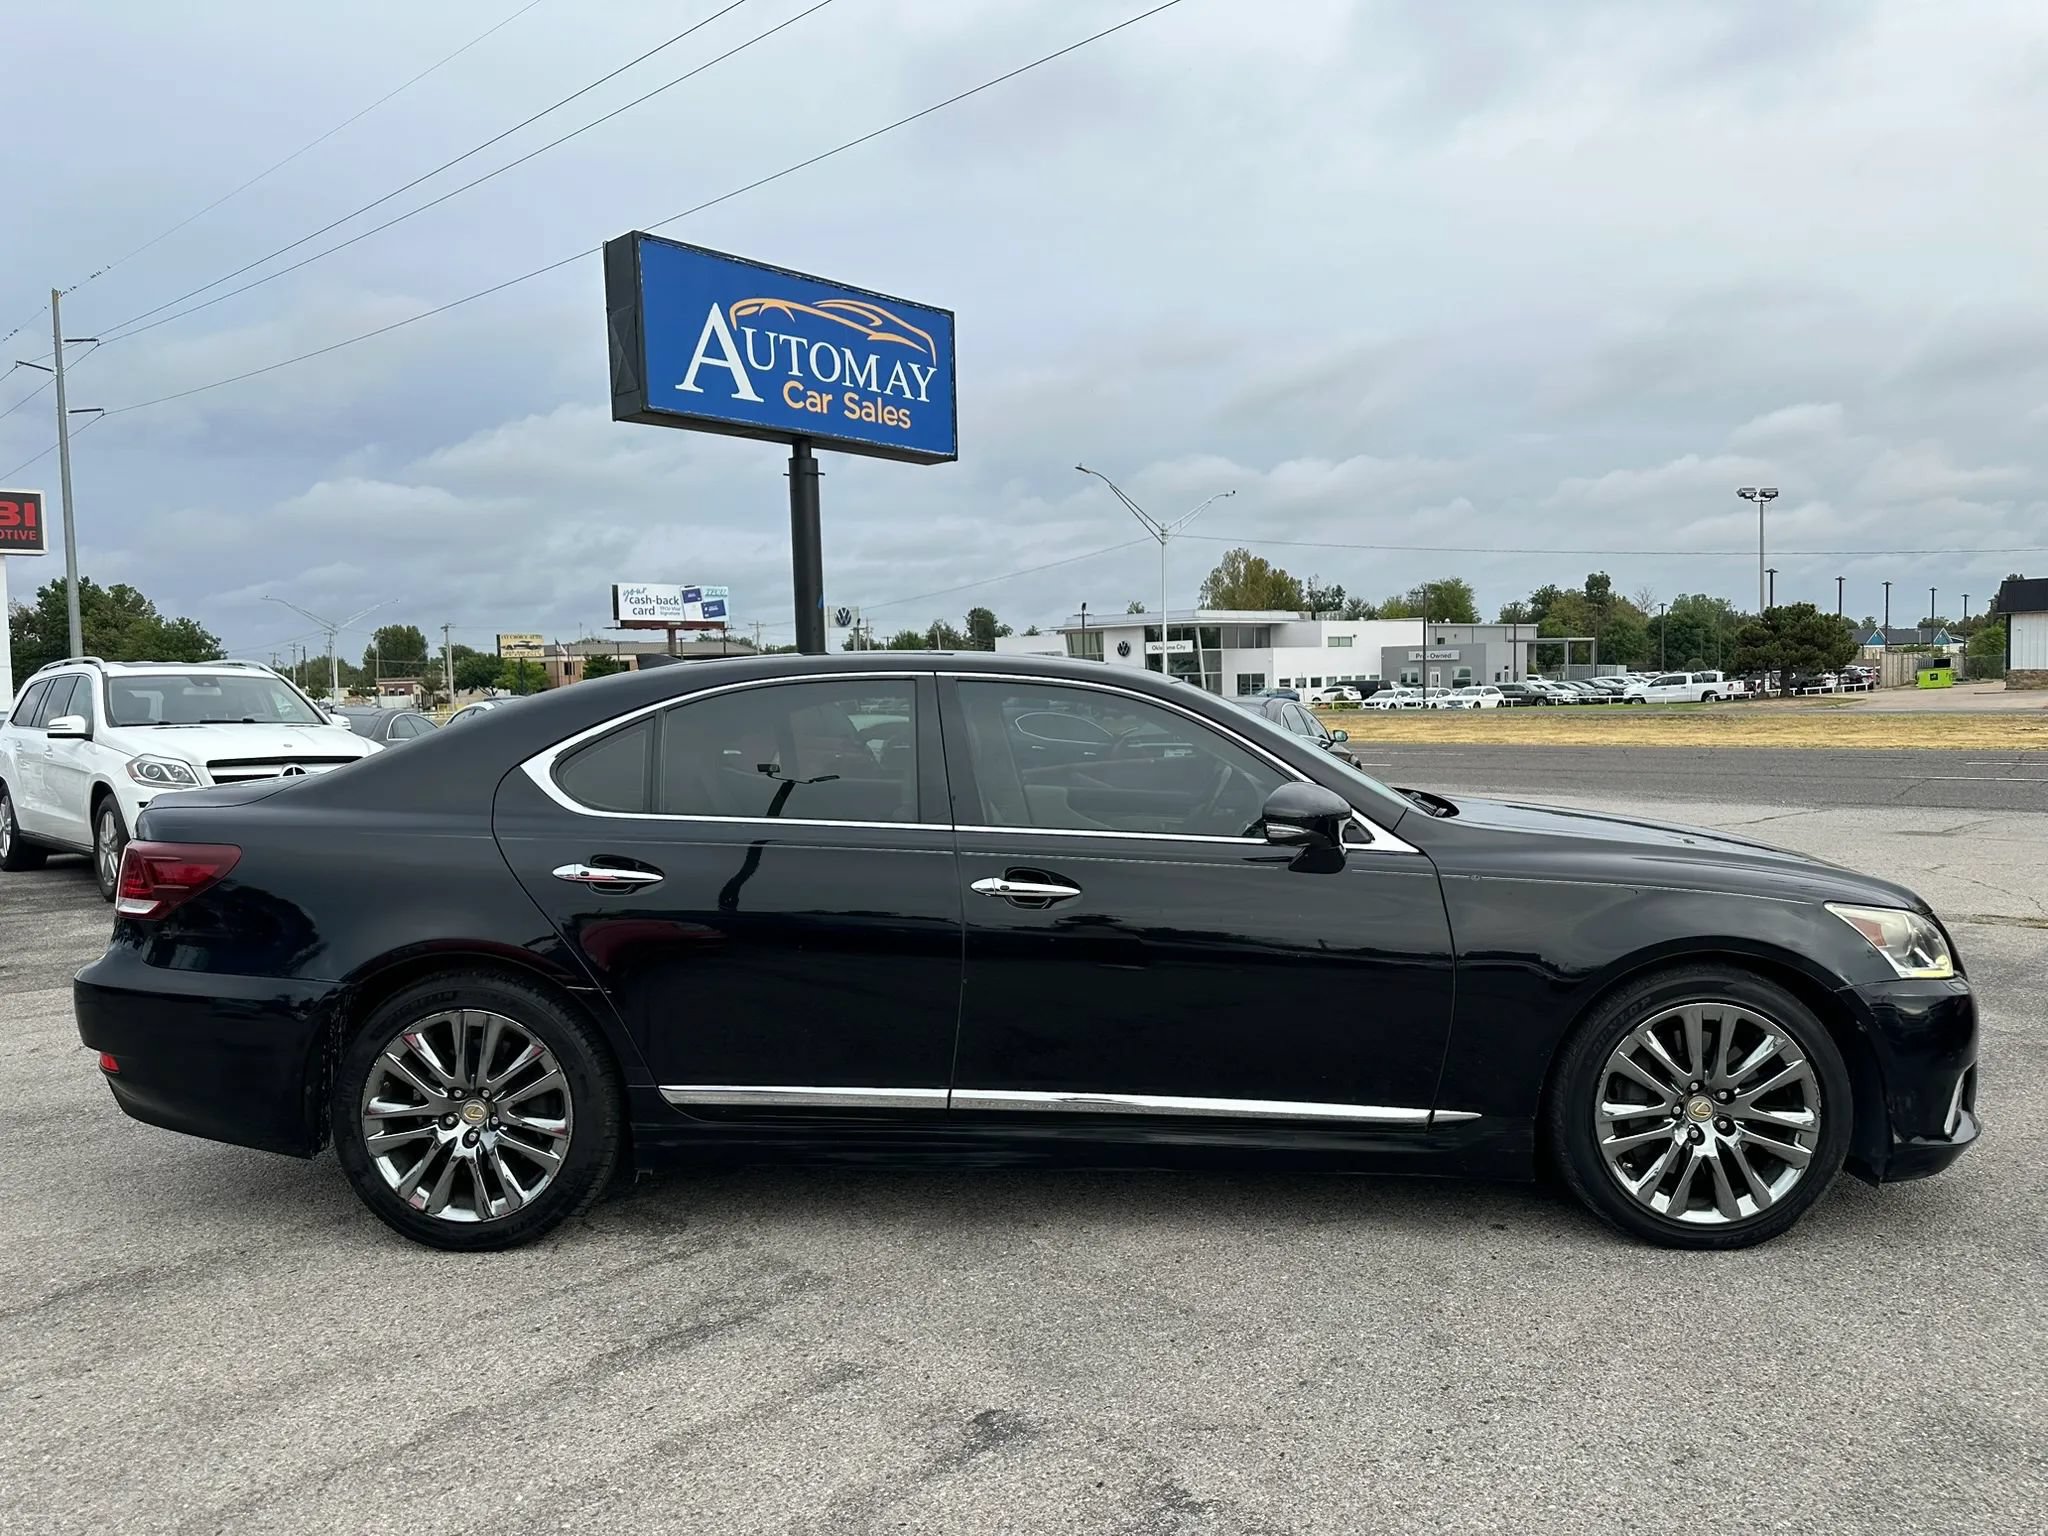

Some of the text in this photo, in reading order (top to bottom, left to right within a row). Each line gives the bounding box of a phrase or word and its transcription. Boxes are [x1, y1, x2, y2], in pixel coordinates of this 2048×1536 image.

[675, 302, 937, 403] AUTOMAY
[782, 381, 912, 430] Car Sales
[629, 595, 679, 606] cash-back
[632, 605, 655, 616] card
